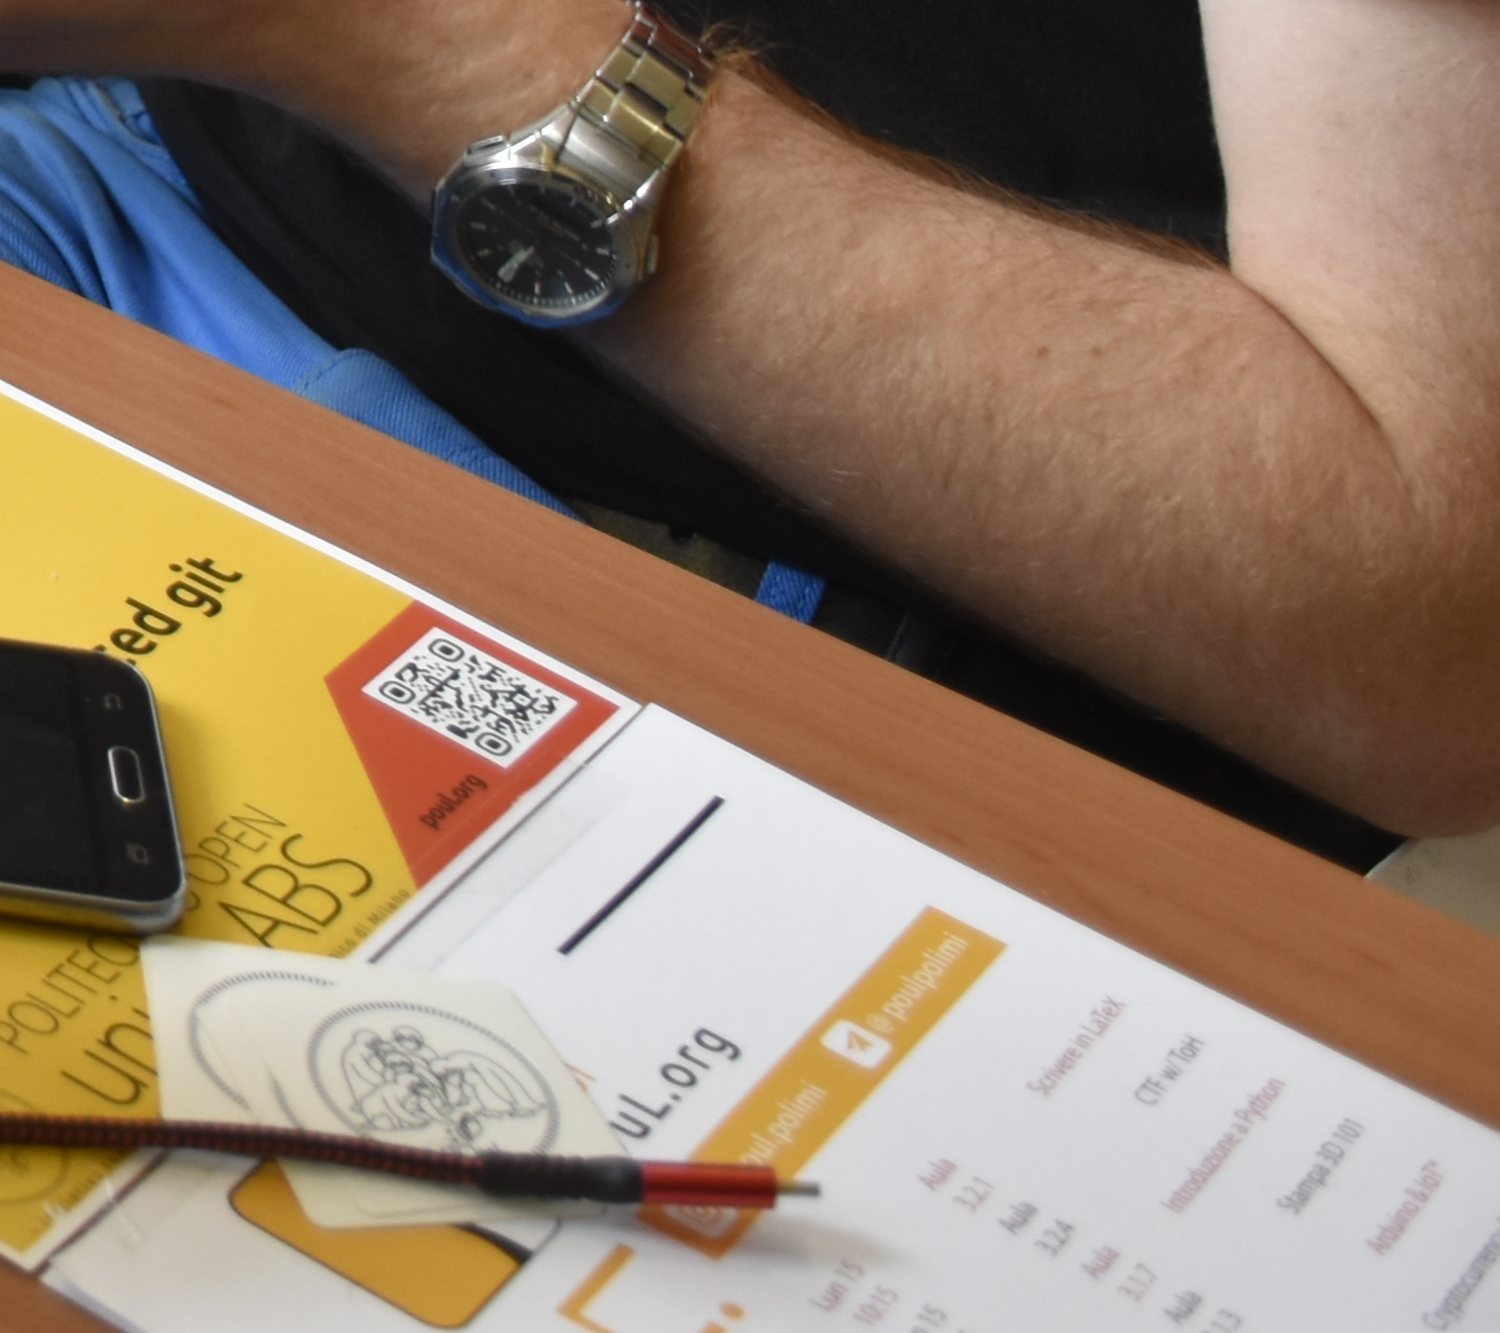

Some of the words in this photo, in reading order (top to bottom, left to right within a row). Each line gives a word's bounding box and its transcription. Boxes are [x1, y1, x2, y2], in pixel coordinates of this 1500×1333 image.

[94, 596, 183, 666] ed
[165, 555, 245, 619] git
[186, 803, 288, 887] OPEN
[218, 832, 374, 949] ABS
[366, 888, 410, 924] Milano
[881, 930, 969, 1022] poulpolimi
[1080, 994, 1127, 1037] LaTeX
[1068, 1033, 1095, 1051] in
[608, 1026, 743, 1142] uL.org
[1025, 1046, 1083, 1097] Scrivere
[1134, 1075, 1167, 1106] CTF
[739, 1079, 829, 1167] oul.polimi
[1160, 1131, 1243, 1214] Introduzione
[1233, 1077, 1286, 1126] Python
[918, 1158, 957, 1191] Aula
[1276, 1162, 1331, 1216] Stampa
[1315, 1140, 1346, 1167] 3D
[1332, 1117, 1366, 1145] 101
[998, 1201, 1038, 1235] Aula
[1366, 1200, 1420, 1257] Arduino
[808, 1282, 848, 1313] Lun
[835, 1258, 866, 1282] 15
[1081, 1245, 1120, 1281] Aula
[852, 1284, 900, 1326] 10:15
[917, 1303, 947, 1327] 15
[1163, 1290, 1203, 1326] Aula
